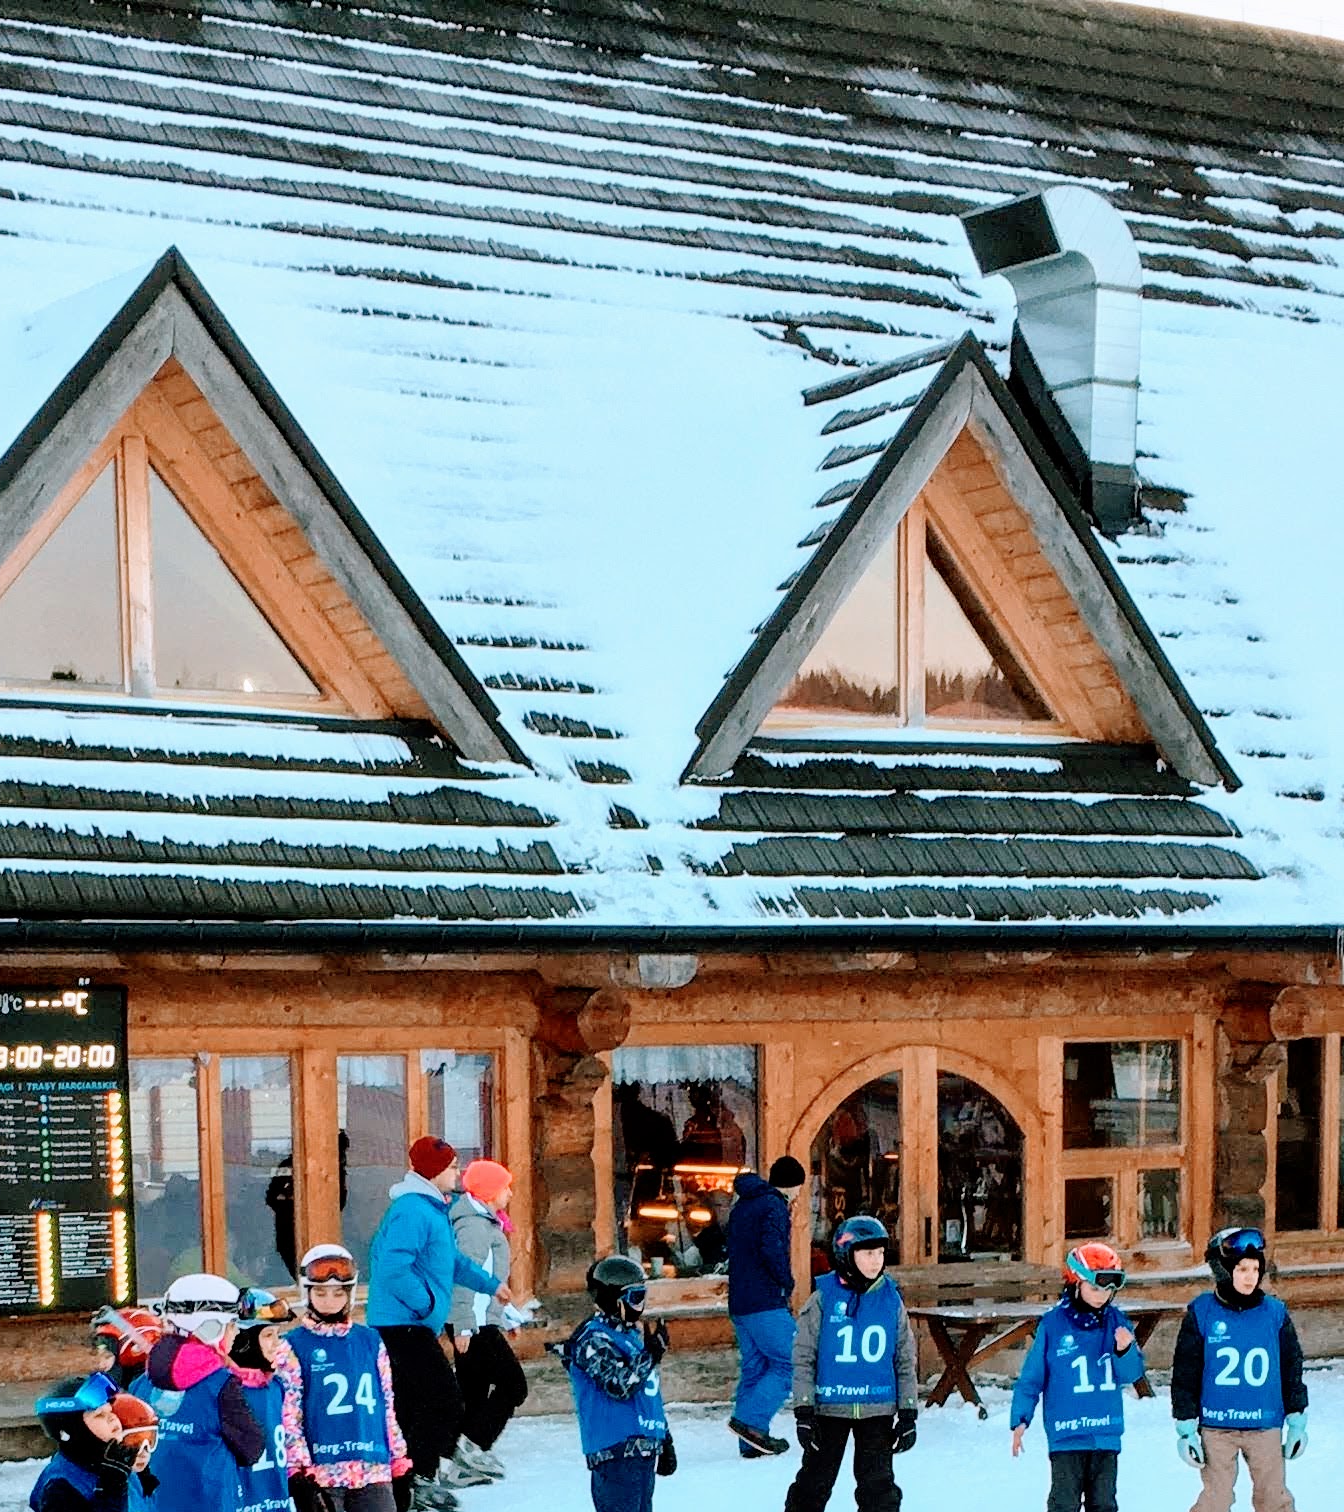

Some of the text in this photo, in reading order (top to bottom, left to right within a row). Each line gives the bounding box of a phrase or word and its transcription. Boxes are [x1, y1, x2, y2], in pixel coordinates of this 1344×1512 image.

[26, 1082, 56, 1091] TRASY
[835, 1325, 887, 1363] 10
[1071, 1353, 1116, 1393] 11
[1215, 1347, 1269, 1387] 20
[45, 1400, 76, 1409] HEAD
[323, 1372, 377, 1416] 24
[159, 1418, 194, 1434] Travel
